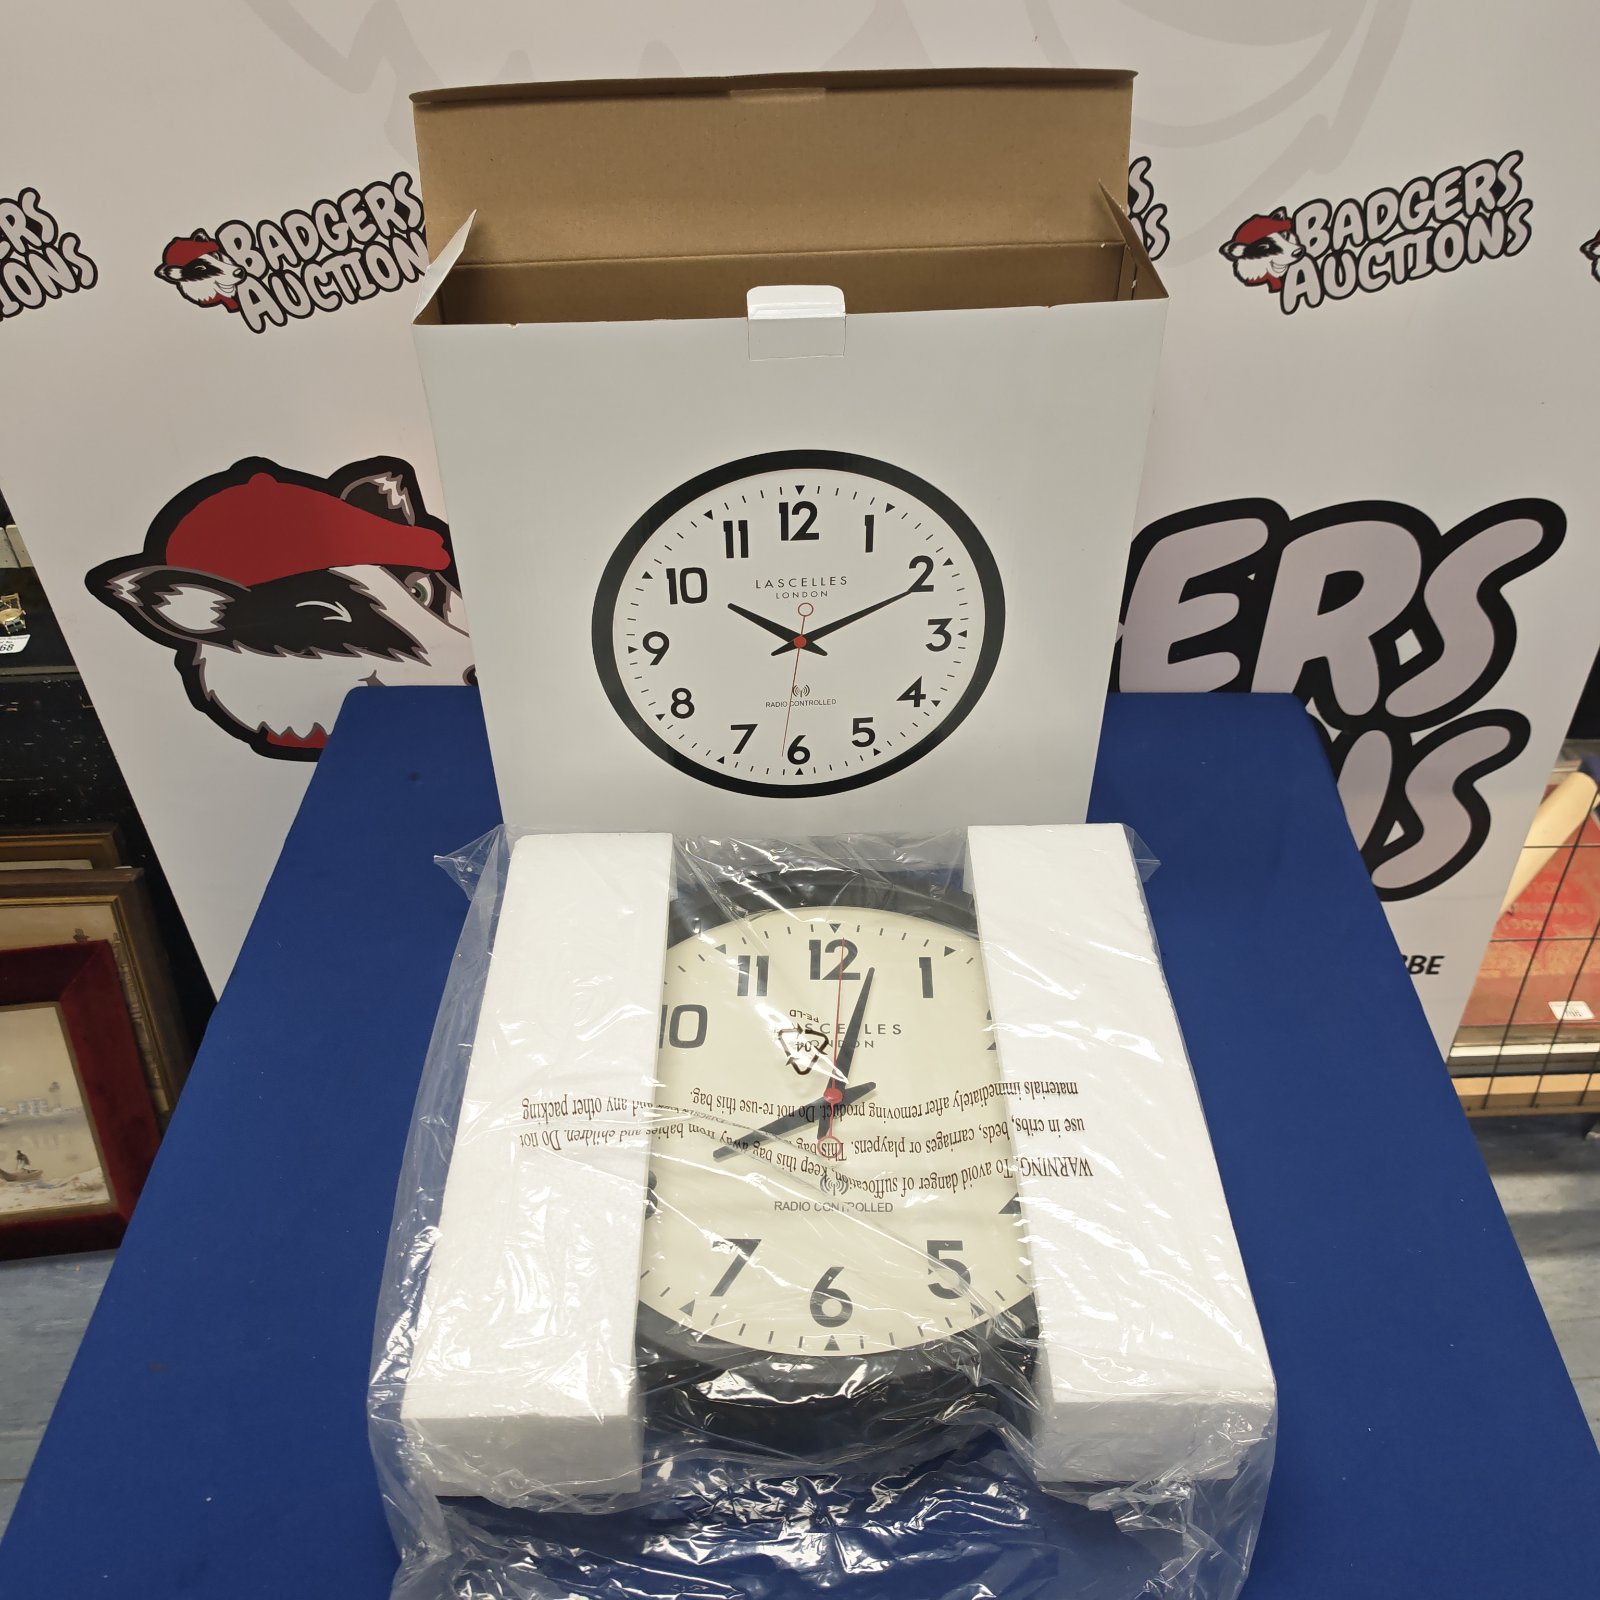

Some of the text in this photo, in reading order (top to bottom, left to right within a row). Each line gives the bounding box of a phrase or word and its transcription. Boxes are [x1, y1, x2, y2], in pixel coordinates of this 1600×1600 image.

[1292, 150, 1524, 261] BADGERS
[214, 171, 425, 280] BADGERS
[1280, 198, 1533, 315] AUCTIONS
[237, 229, 430, 334] AUCTION
[778, 500, 820, 542] 12
[722, 519, 749, 559] 11
[864, 514, 875, 554] 1
[665, 566, 708, 605] 10
[755, 575, 848, 589] LASCELLES
[908, 555, 935, 593] 2
[775, 590, 828, 600] LONDON
[925, 618, 953, 652] 3
[642, 630, 670, 666] 9
[670, 687, 695, 719] 8
[789, 699, 837, 707] CONTROLLED
[895, 675, 926, 708] 4
[730, 723, 759, 755] 7
[851, 716, 876, 748] 5
[787, 734, 811, 766] 6
[808, 939, 861, 981] 12
[1402, 954, 1446, 975] BE
[736, 954, 770, 997] 11
[918, 956, 934, 999] 1
[774, 1022, 902, 1036] SCELES
[690, 1087, 713, 1112] bag.
[952, 1081, 1021, 1112] immediately
[1023, 1081, 1079, 1100] materials
[521, 1093, 568, 1125] packing
[572, 1097, 602, 1120] other
[606, 1096, 628, 1112] any
[715, 1095, 736, 1115] this
[739, 1099, 774, 1117] re-use
[776, 1104, 795, 1119] not
[799, 1105, 815, 1123] Do
[820, 1102, 865, 1122] product.
[868, 1102, 923, 1124] removing
[925, 1096, 950, 1117] after
[646, 1122, 683, 1139] babies
[978, 1121, 1010, 1144] beds,
[1011, 1115, 1045, 1137] cribs,
[1048, 1119, 1061, 1139] in
[1064, 1118, 1085, 1133] use
[519, 1132, 539, 1149] not
[541, 1130, 562, 1151] Do
[752, 1140, 773, 1163] bag
[796, 1137, 817, 1155] bag
[821, 1142, 847, 1162] This
[850, 1135, 906, 1158] playpens.
[909, 1141, 922, 1154] or
[925, 1126, 975, 1155] carriages
[776, 1152, 797, 1173] this
[799, 1157, 828, 1183] keep
[995, 1158, 1013, 1179] To
[918, 1172, 959, 1194] danger
[961, 1161, 992, 1190] avoid
[900, 1177, 915, 1198] of
[774, 1201, 811, 1212] RADIO
[709, 1238, 762, 1297] 7
[926, 1239, 972, 1300] 5
[809, 1266, 854, 1328] 6
